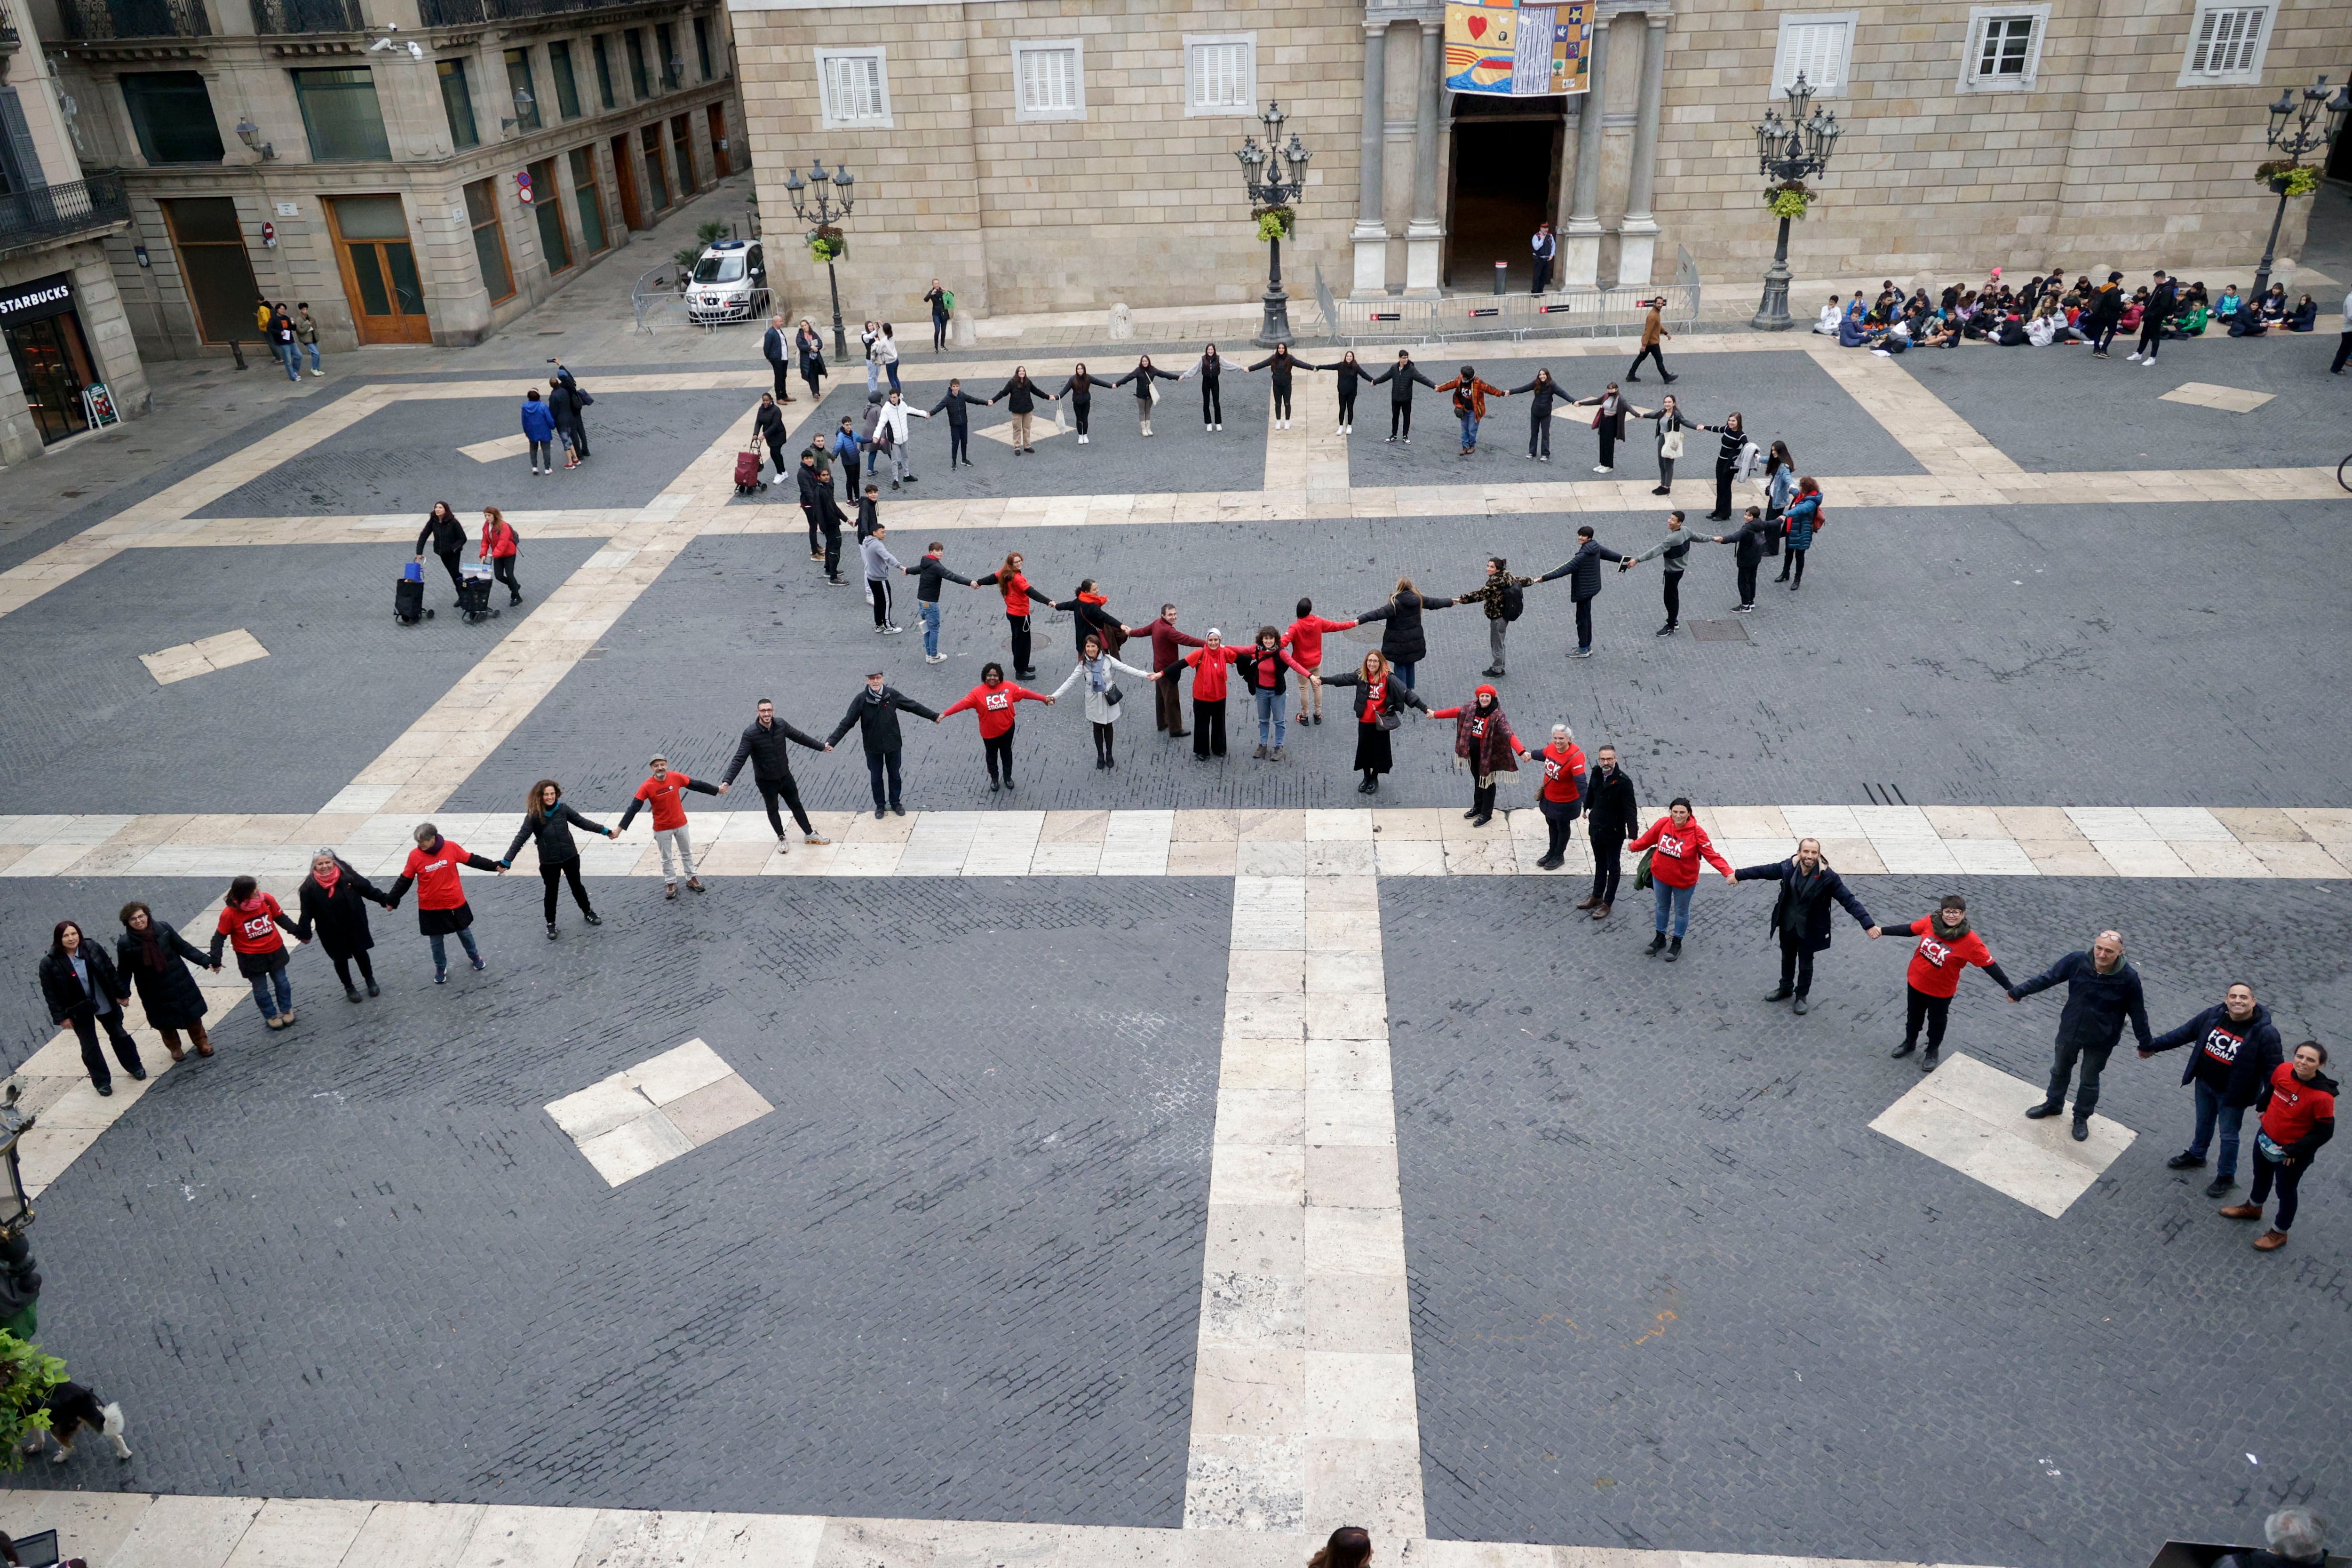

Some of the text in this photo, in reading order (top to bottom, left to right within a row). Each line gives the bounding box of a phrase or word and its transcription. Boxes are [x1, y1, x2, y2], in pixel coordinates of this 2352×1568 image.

[0, 285, 69, 313] STARBUCKS
[986, 693, 1007, 706] FCK
[1658, 845, 1681, 859] STIGMA
[1660, 835, 1684, 852] FCK
[244, 915, 271, 933] FCK
[248, 925, 273, 939] STIGMA
[1920, 948, 1942, 967] STIGMA
[1921, 938, 1951, 962] FCK
[2208, 1029, 2241, 1055] FCK
[2205, 1042, 2234, 1061] STIGMA
